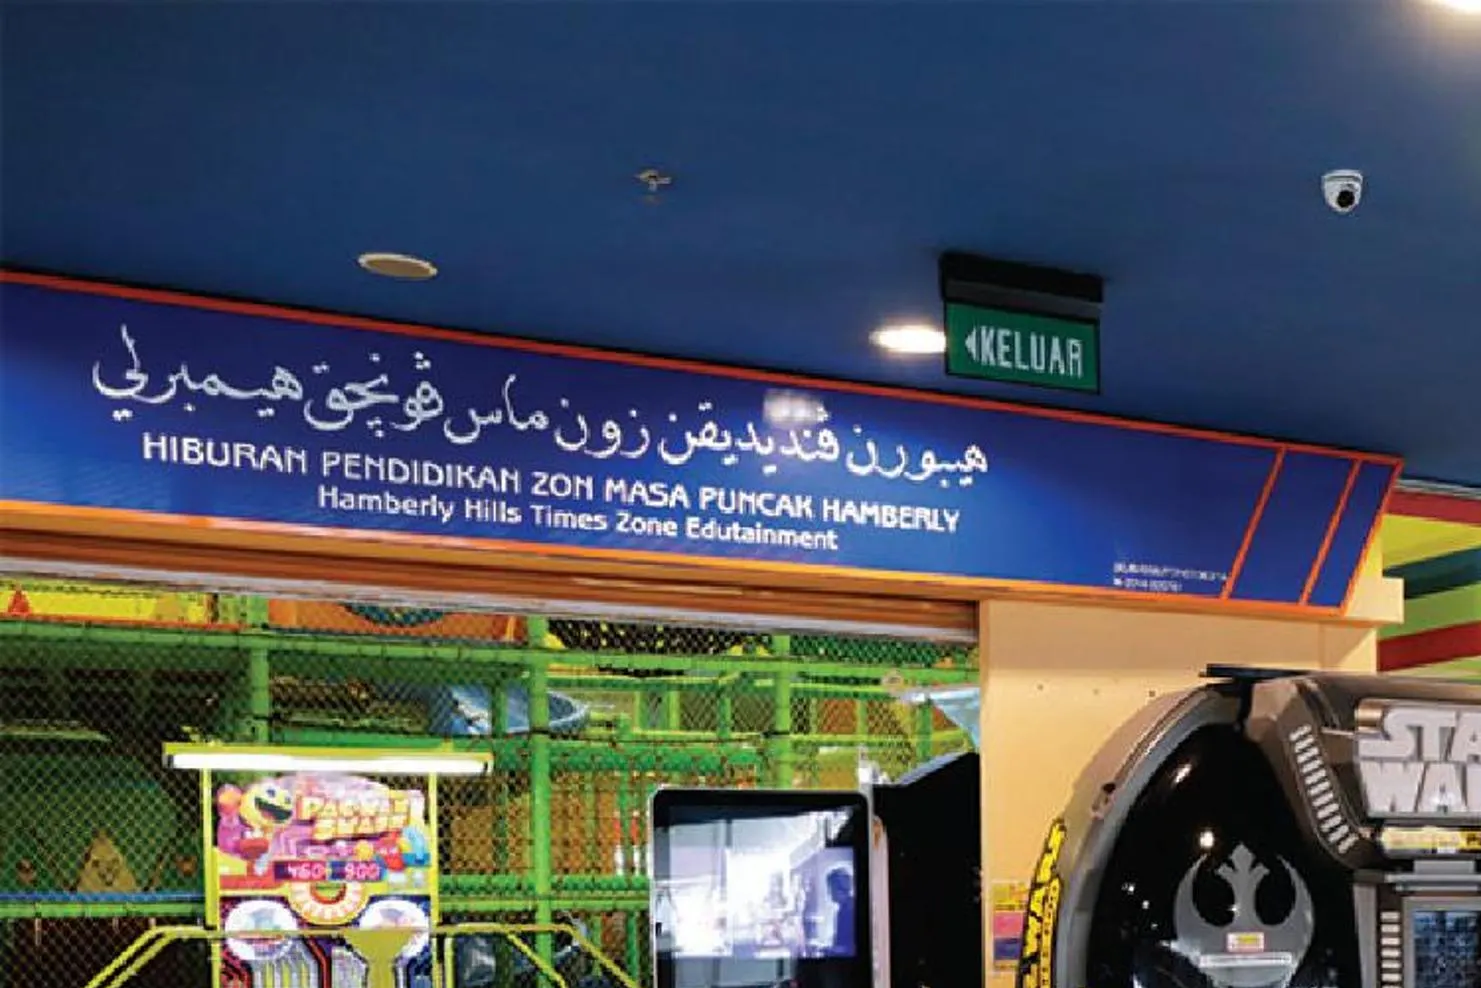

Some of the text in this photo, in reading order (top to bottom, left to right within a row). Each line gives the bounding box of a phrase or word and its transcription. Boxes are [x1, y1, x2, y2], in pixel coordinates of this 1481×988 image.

[980, 325, 1083, 379] KELUAR
[443, 373, 550, 443] ماس
[554, 397, 650, 459] زون
[142, 431, 961, 534] HIBURAN PENDIDIKAN ZON MASA PUNCAK HAMBERLY
[318, 484, 839, 551] Hamberly Hills Times Zone Edutainment
